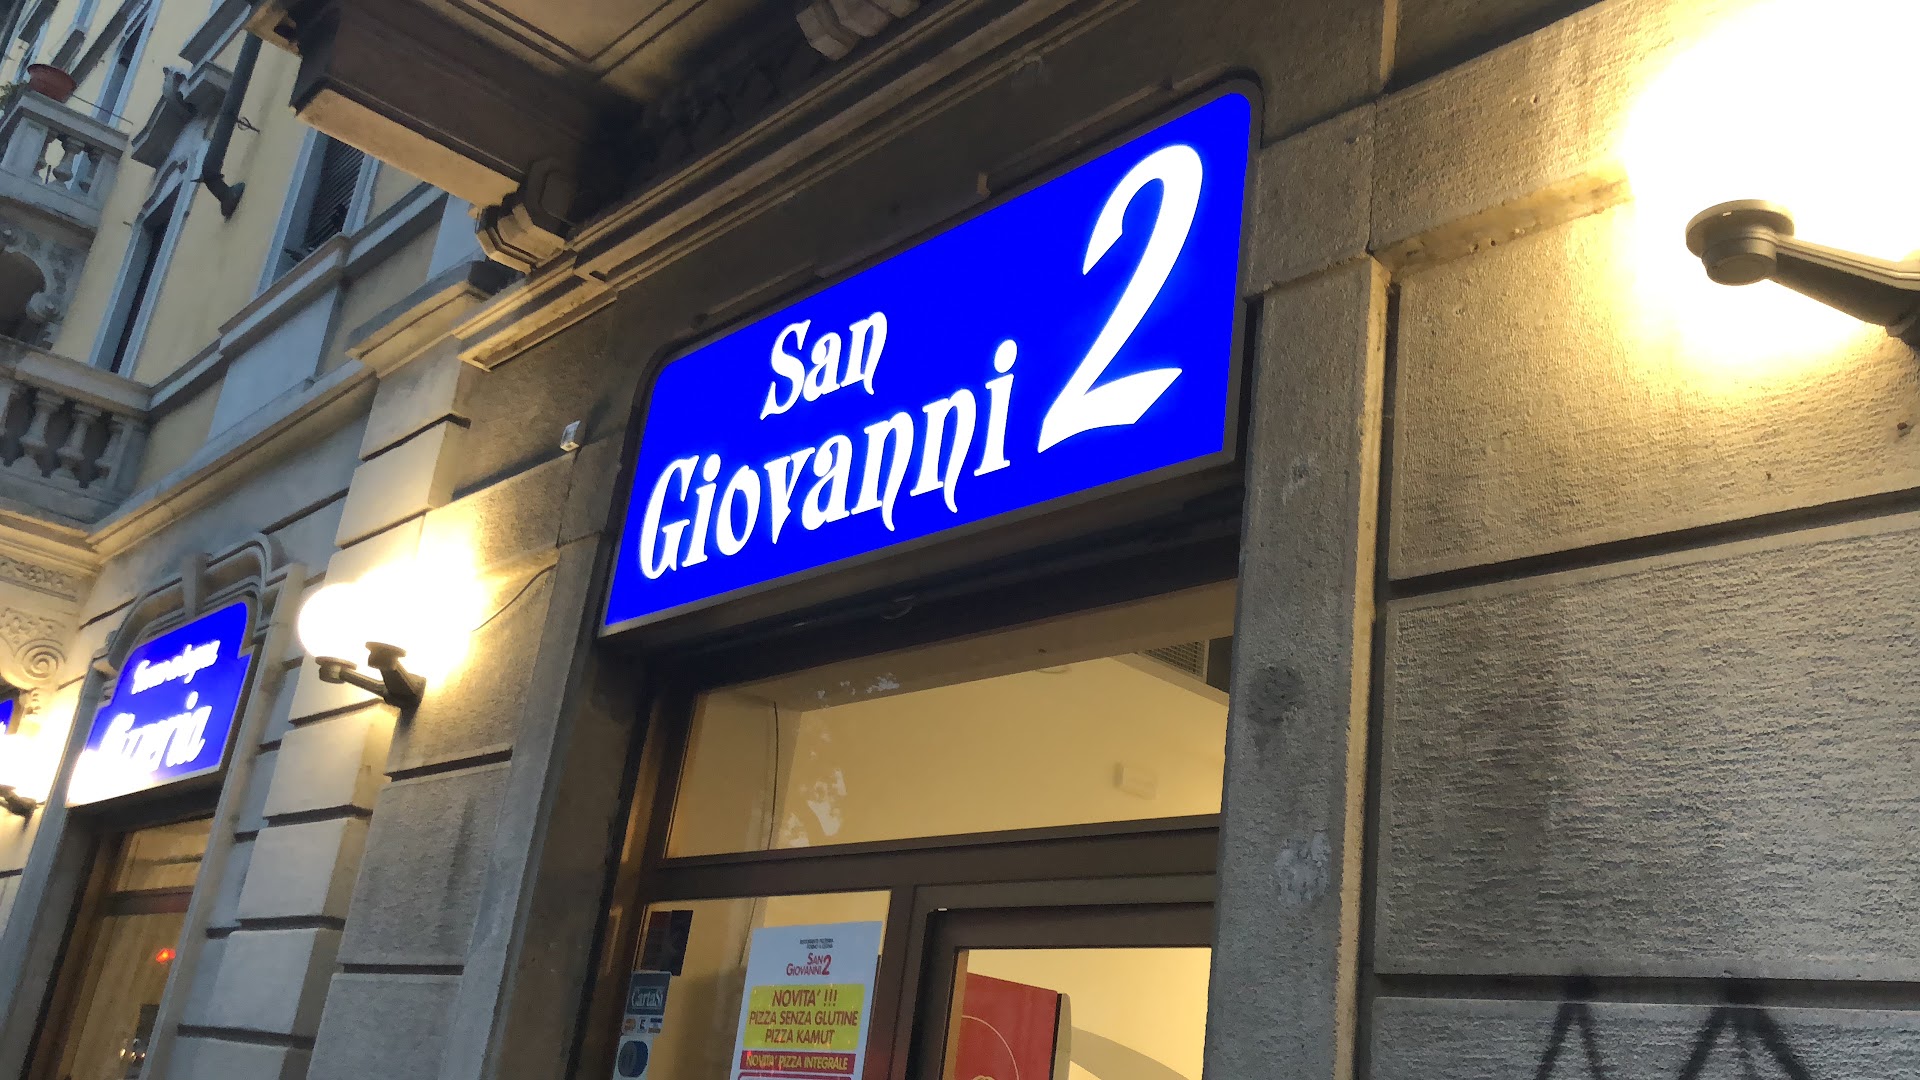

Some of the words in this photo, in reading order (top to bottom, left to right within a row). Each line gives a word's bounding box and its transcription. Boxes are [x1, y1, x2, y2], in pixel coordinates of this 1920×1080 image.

[1037, 144, 1204, 453] 2
[760, 311, 888, 421] San
[639, 339, 1019, 581] Giovanni
[821, 954, 832, 976] 2
[823, 989, 838, 1007] !!!
[749, 1010, 777, 1026] PIZZA
[779, 1010, 812, 1026] SENZA
[814, 1010, 859, 1026] GLUTINE
[764, 1028, 793, 1044] PIZZA
[796, 1029, 836, 1044] KAMUT
[778, 1055, 802, 1068] PIZZA
[803, 1056, 849, 1070] INTEGRALE
